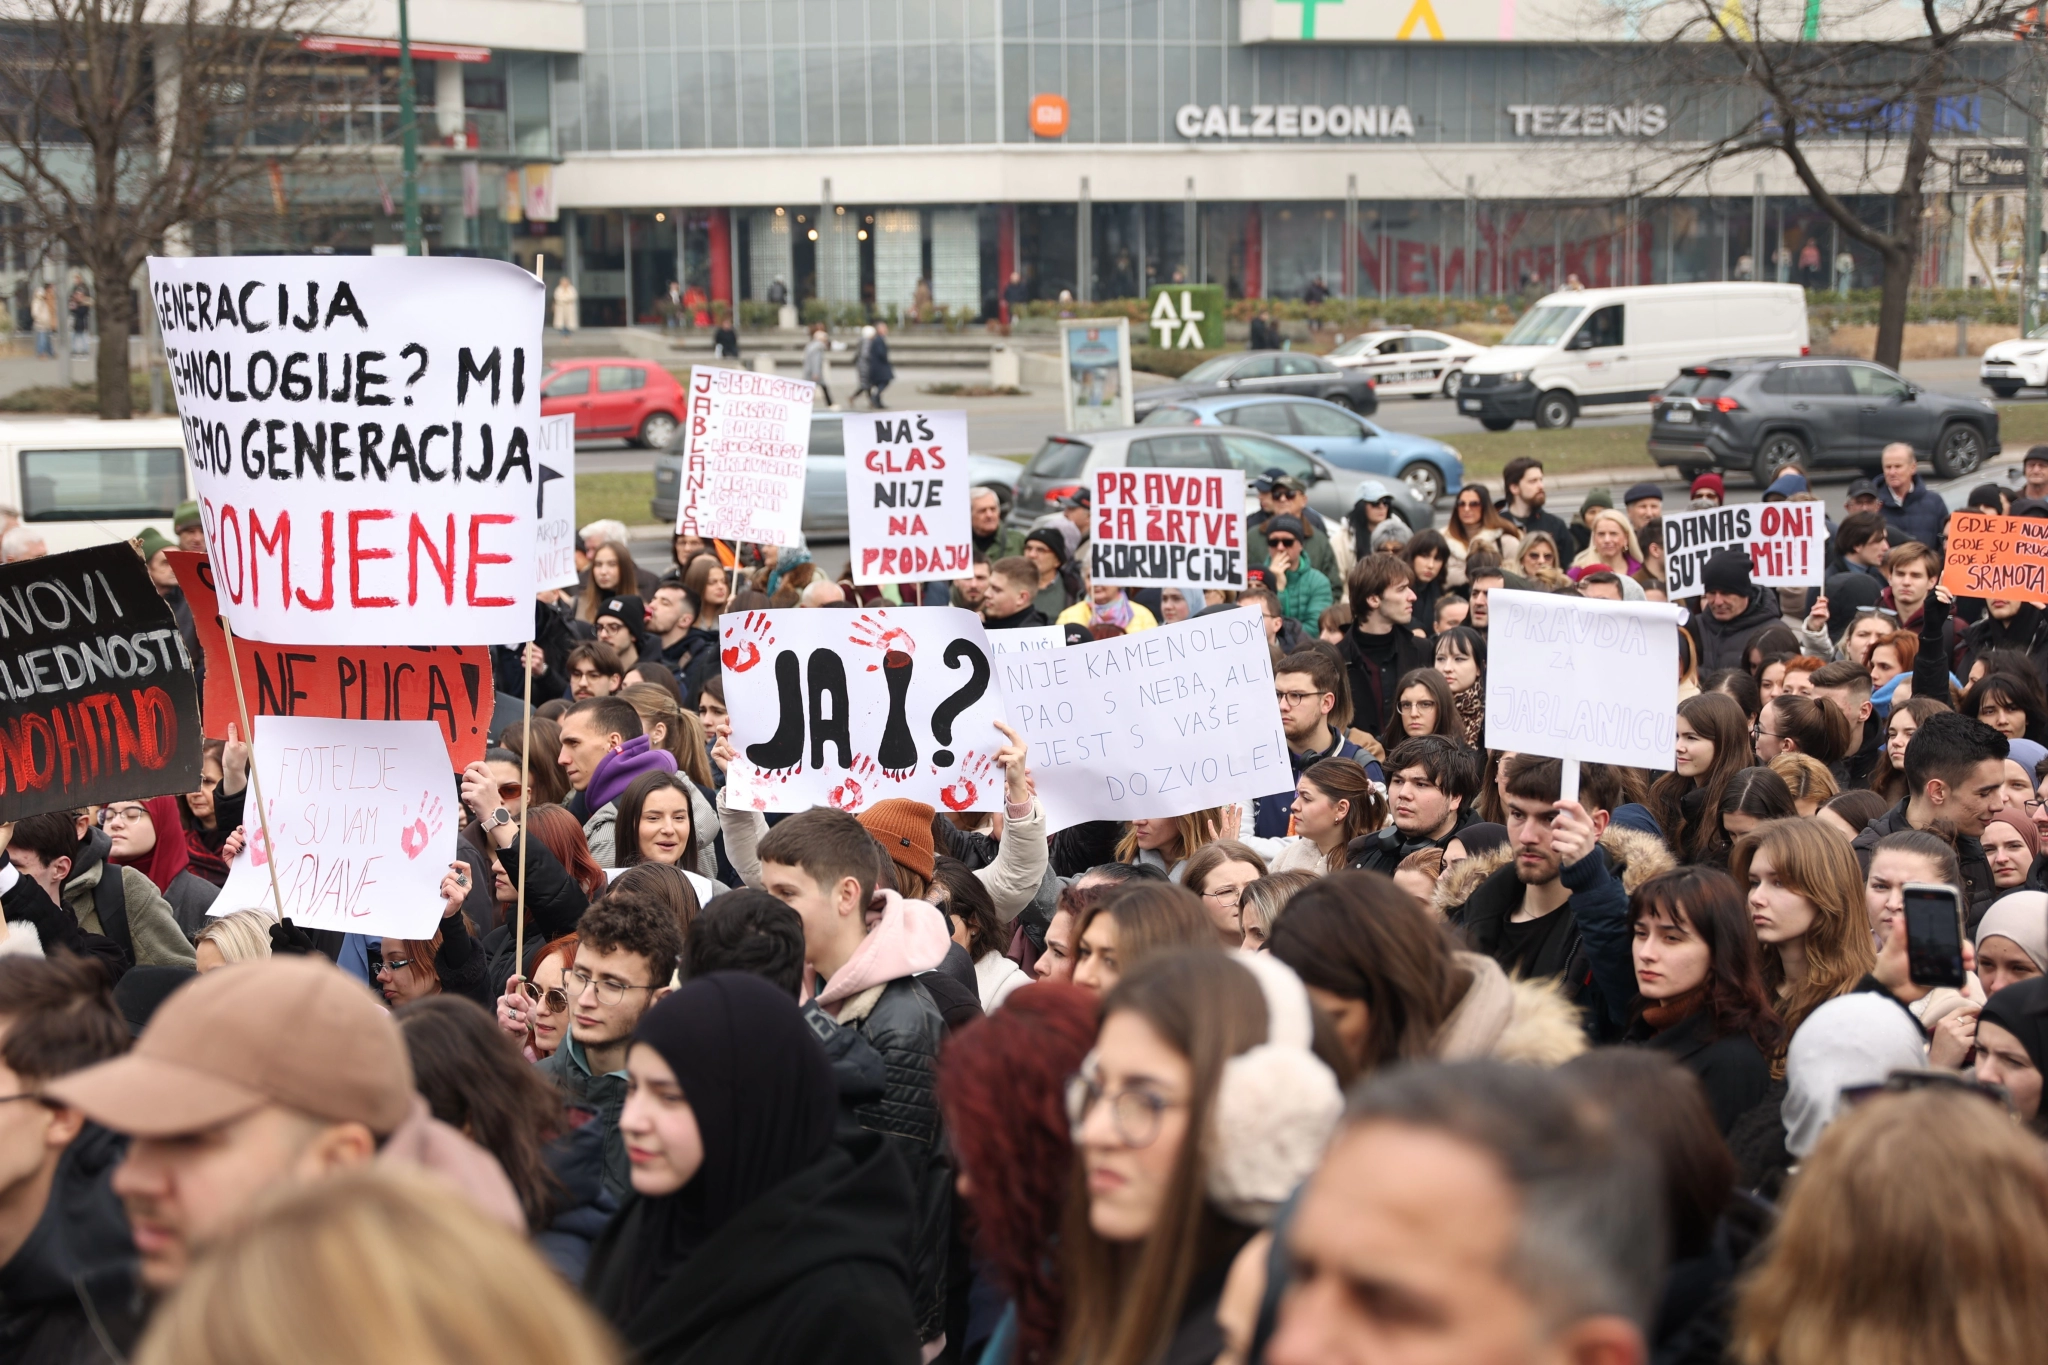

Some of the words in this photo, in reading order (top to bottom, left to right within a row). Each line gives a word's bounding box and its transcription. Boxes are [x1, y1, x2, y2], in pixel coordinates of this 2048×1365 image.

[1176, 104, 1415, 138] CALZEDONIA
[1507, 103, 1668, 136] TEZENIS
[154, 280, 369, 334] GENERACIJA
[456, 346, 526, 406] MI
[241, 418, 533, 484] GENERACIJA
[874, 414, 935, 444] NAŠ
[865, 446, 946, 475] GLAS
[873, 479, 944, 509] NIJE
[1097, 472, 1223, 509] PRAVDA
[888, 514, 929, 536] NA
[1098, 508, 1137, 541] ZA
[1146, 504, 1239, 548] ŽRTVE
[1665, 508, 1752, 555] DANAS
[1952, 538, 1985, 551] GDJE
[1990, 539, 2010, 552] SU
[1956, 516, 1997, 533] GDJE
[2001, 520, 2018, 534] JE
[862, 543, 970, 576] PRODAJU
[1948, 553, 1978, 566] GDJE
[1982, 553, 1997, 564] JE
[1966, 564, 2048, 594] SRAMOTA
[1504, 603, 1648, 656] PRAVDA
[0, 629, 191, 700] IJEDNOSTI
[1006, 659, 1069, 693] NIJE
[1085, 614, 1267, 680] KAMENOLOM
[1549, 651, 1576, 671] ZA
[254, 651, 317, 718] NE
[1016, 701, 1073, 733] PAO
[1103, 691, 1117, 714] S
[1139, 672, 1217, 708] NEBA,
[1225, 659, 1270, 689] ALI
[746, 647, 862, 776] JA
[1492, 685, 1675, 754] JABLANICU
[1035, 731, 1113, 768] JEST
[1130, 724, 1144, 749] S
[1174, 703, 1240, 737] VAŠE
[278, 744, 399, 797] FOTELJE
[1106, 730, 1285, 801] DOZVOLE!
[295, 803, 331, 846] SU
[342, 803, 379, 845] VAM
